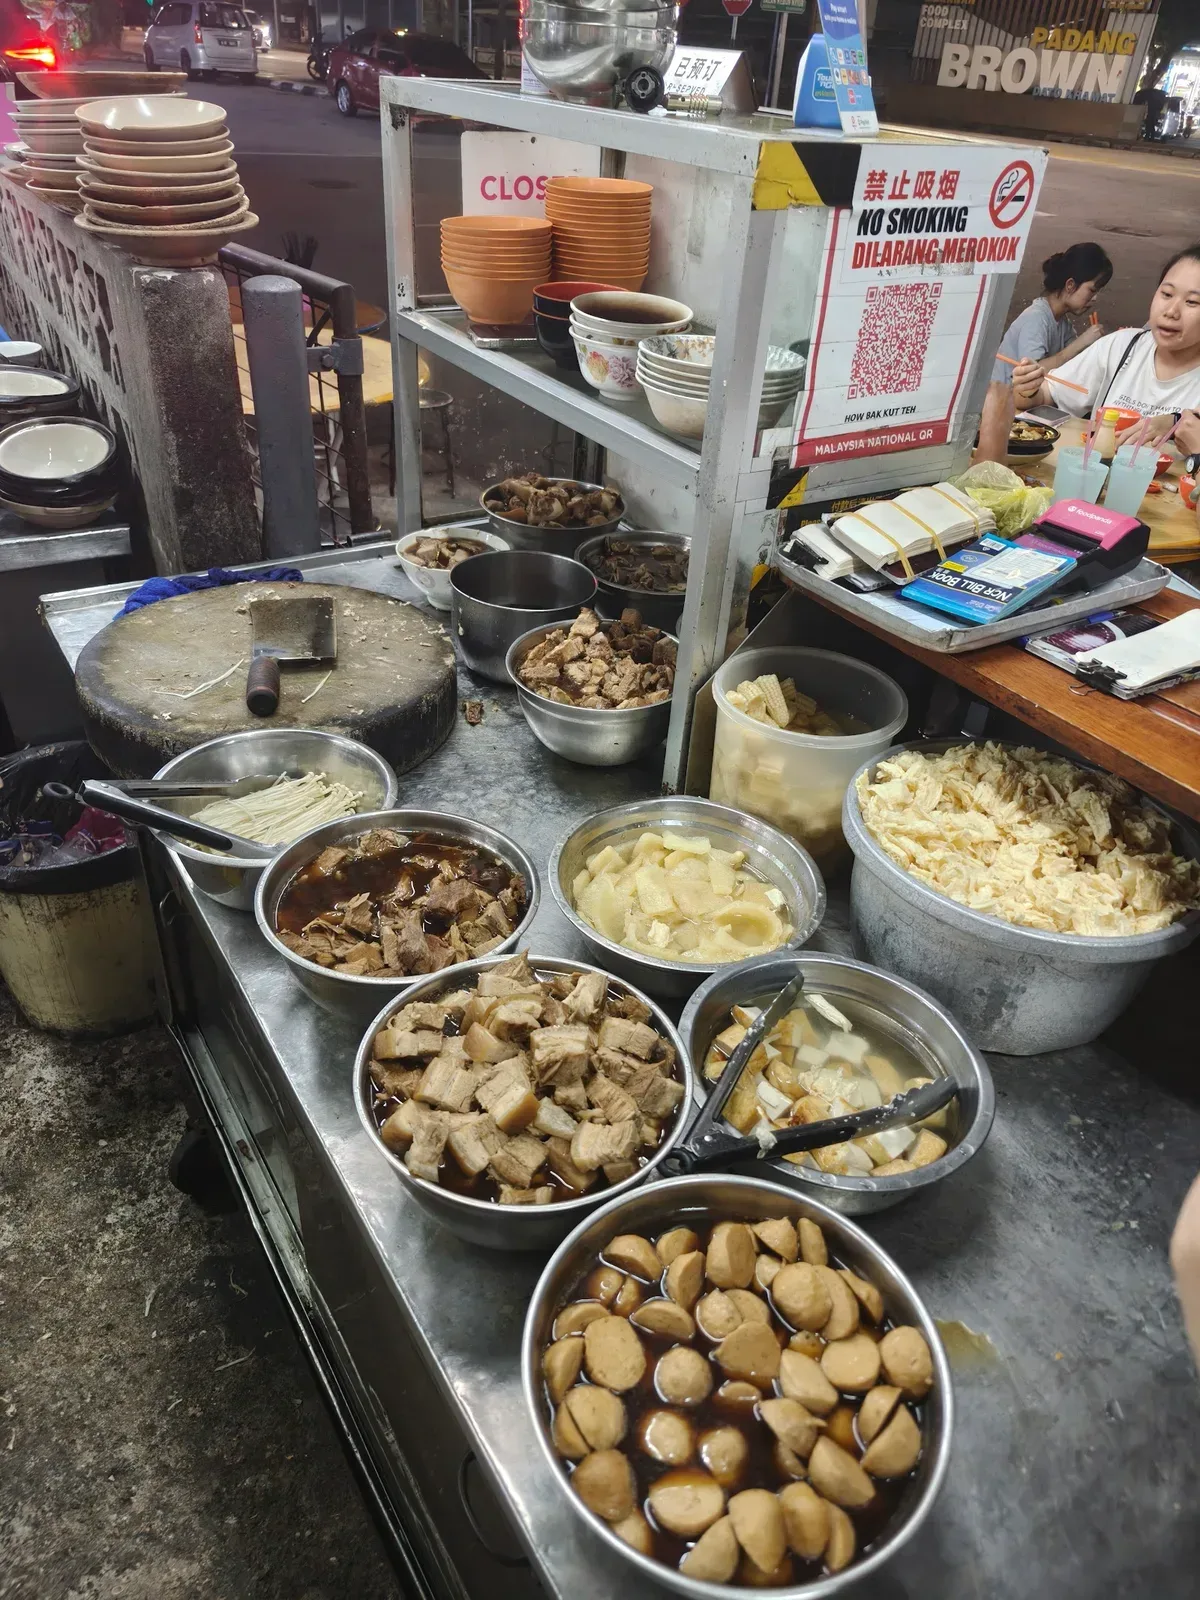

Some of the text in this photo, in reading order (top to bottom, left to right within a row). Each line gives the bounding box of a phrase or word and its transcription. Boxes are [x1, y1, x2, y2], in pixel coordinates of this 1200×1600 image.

[920, 17, 969, 30] COMPLEX
[921, 4, 949, 17] FOOD
[1030, 27, 1138, 56] PADANG
[674, 57, 722, 81] 已预订
[937, 42, 1128, 101] BROWN
[863, 169, 961, 202] 禁止吸烟
[856, 206, 969, 236] NO SMOKING
[851, 236, 1022, 269] DILARANG MEROKOK
[844, 405, 917, 423] HOW BAK KUT TEH
[815, 428, 933, 456] MALAYSIA NATIONAL QR
[1075, 508, 1113, 525] foodpanda
[927, 571, 1013, 602] NCR BILL BOOK
